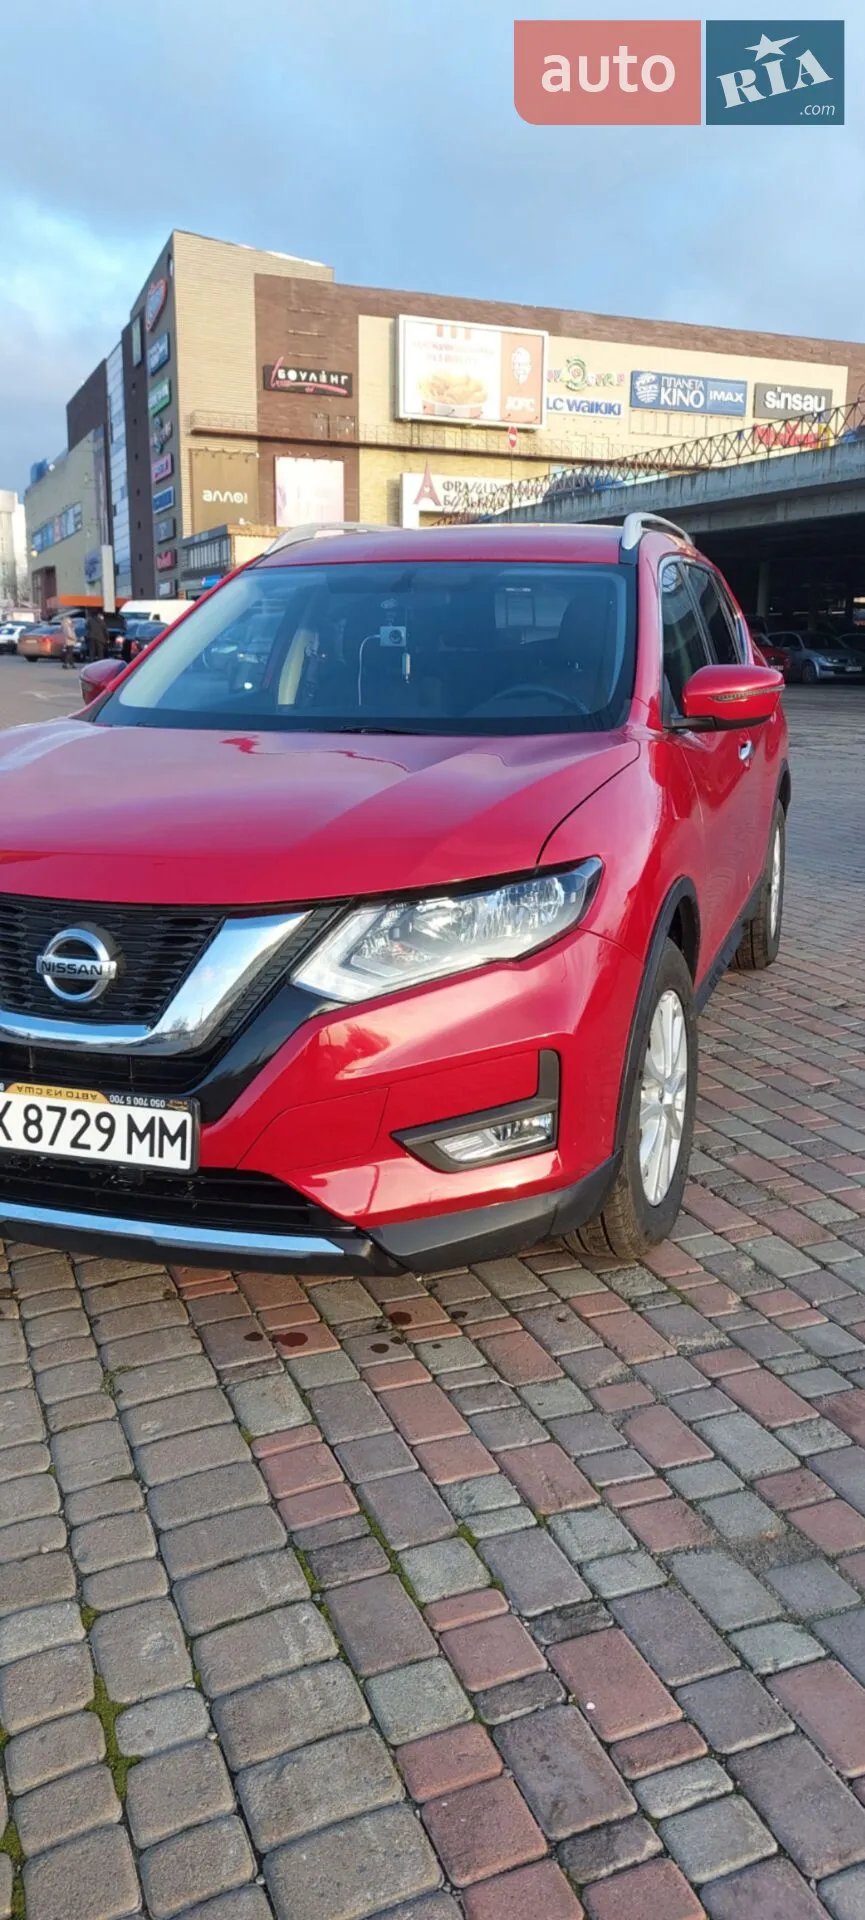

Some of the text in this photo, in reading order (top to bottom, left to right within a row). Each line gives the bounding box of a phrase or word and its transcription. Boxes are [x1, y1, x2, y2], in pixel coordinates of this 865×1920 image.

[546, 397, 564, 411] LC
[709, 390, 744, 404] IMAX
[40, 960, 103, 976] NISSAN
[16, 1085, 98, 1101] АВТО ИЗ США
[22, 1103, 116, 1152] 8729
[126, 1113, 188, 1161] MM
